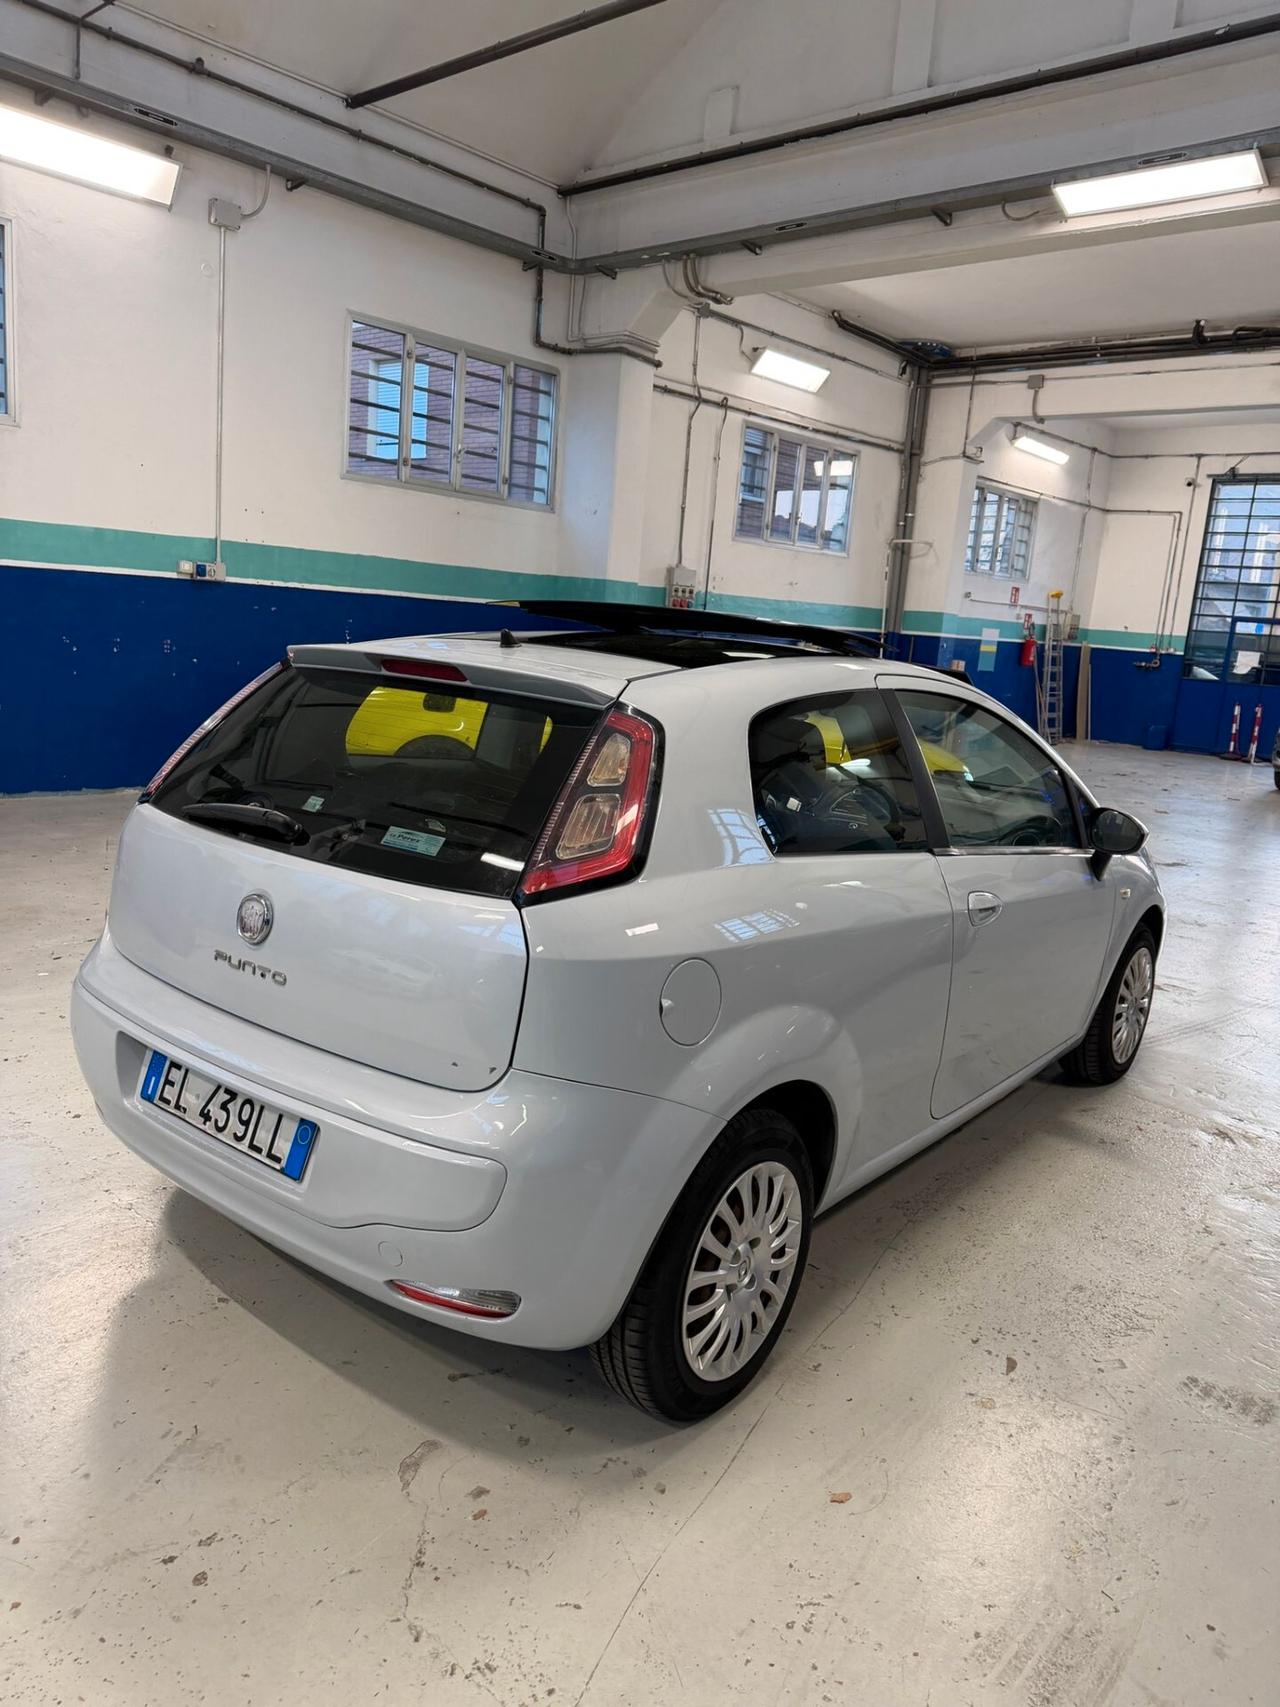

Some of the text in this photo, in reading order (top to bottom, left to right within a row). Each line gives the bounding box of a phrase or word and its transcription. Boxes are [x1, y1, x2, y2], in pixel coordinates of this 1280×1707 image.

[214, 949, 287, 986] PUNTO
[158, 1060, 283, 1165] EL 439LL
